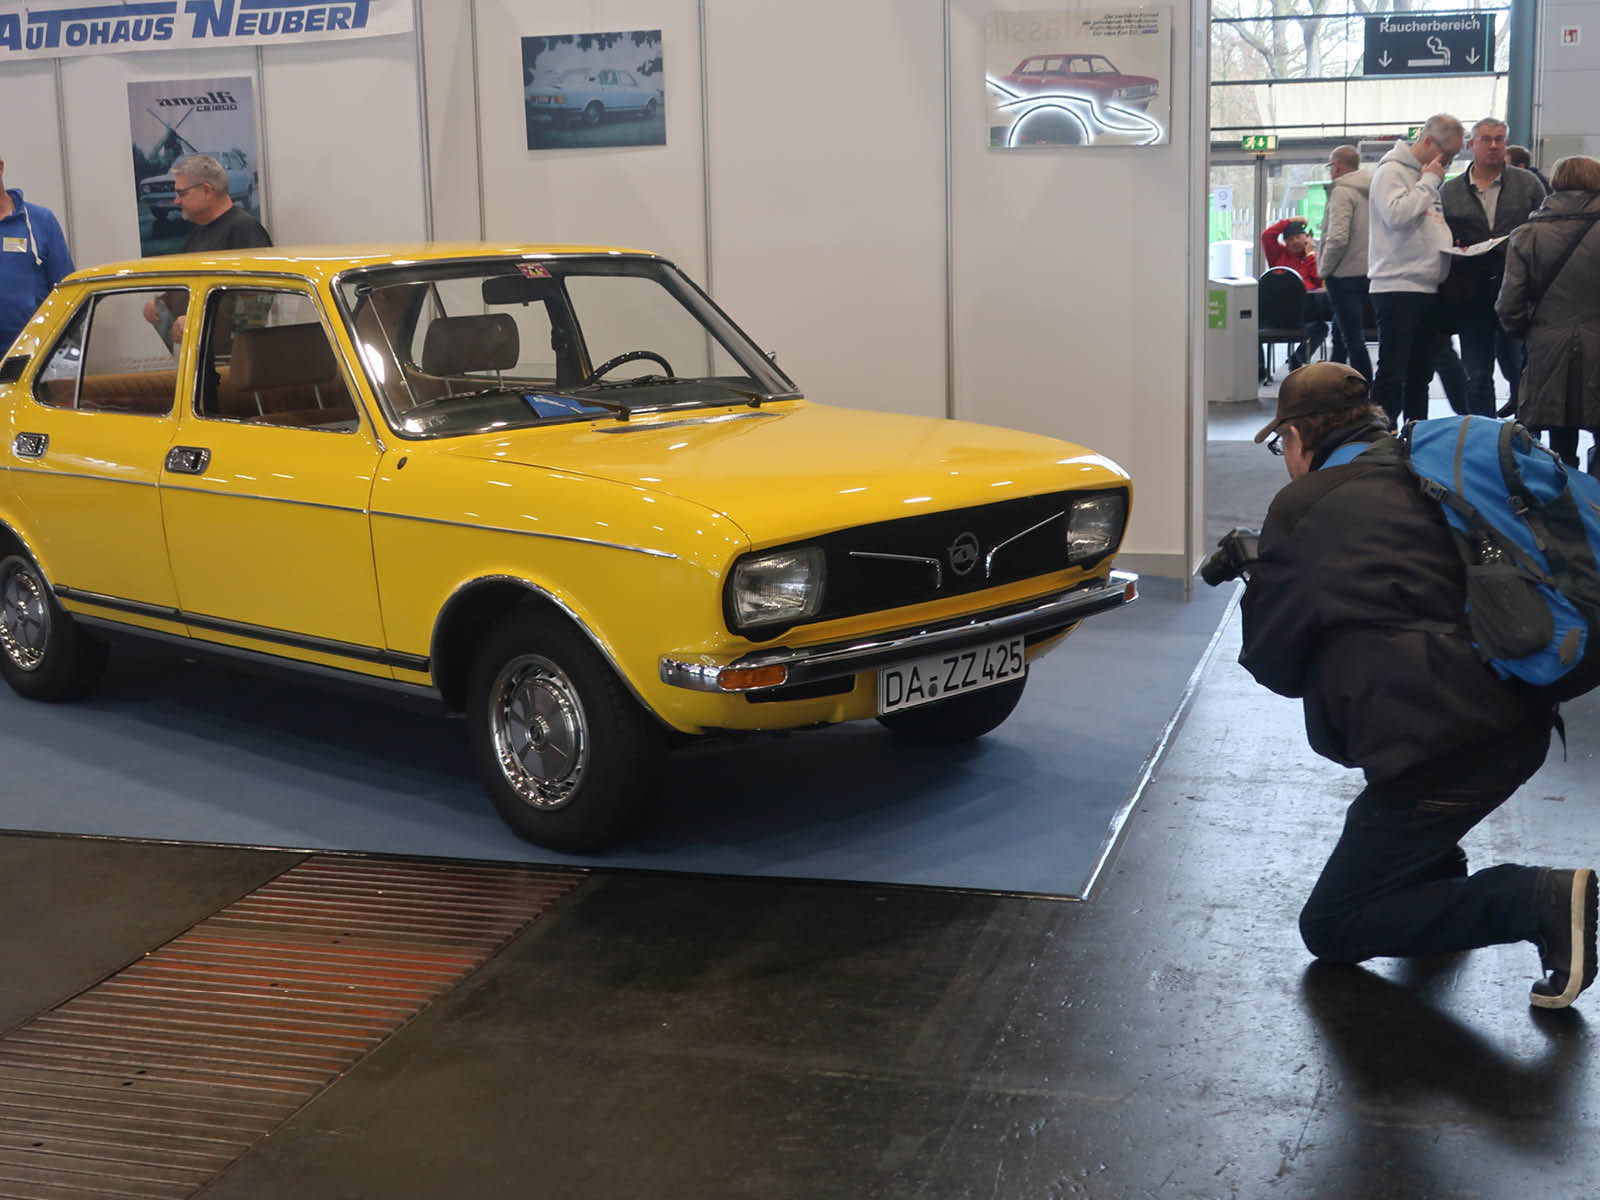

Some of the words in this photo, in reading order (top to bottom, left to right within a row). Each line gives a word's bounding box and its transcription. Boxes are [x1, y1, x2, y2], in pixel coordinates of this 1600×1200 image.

[184, 0, 371, 38] NEUBERT
[1380, 19, 1480, 33] Raucherbereich
[982, 641, 1022, 681] 425
